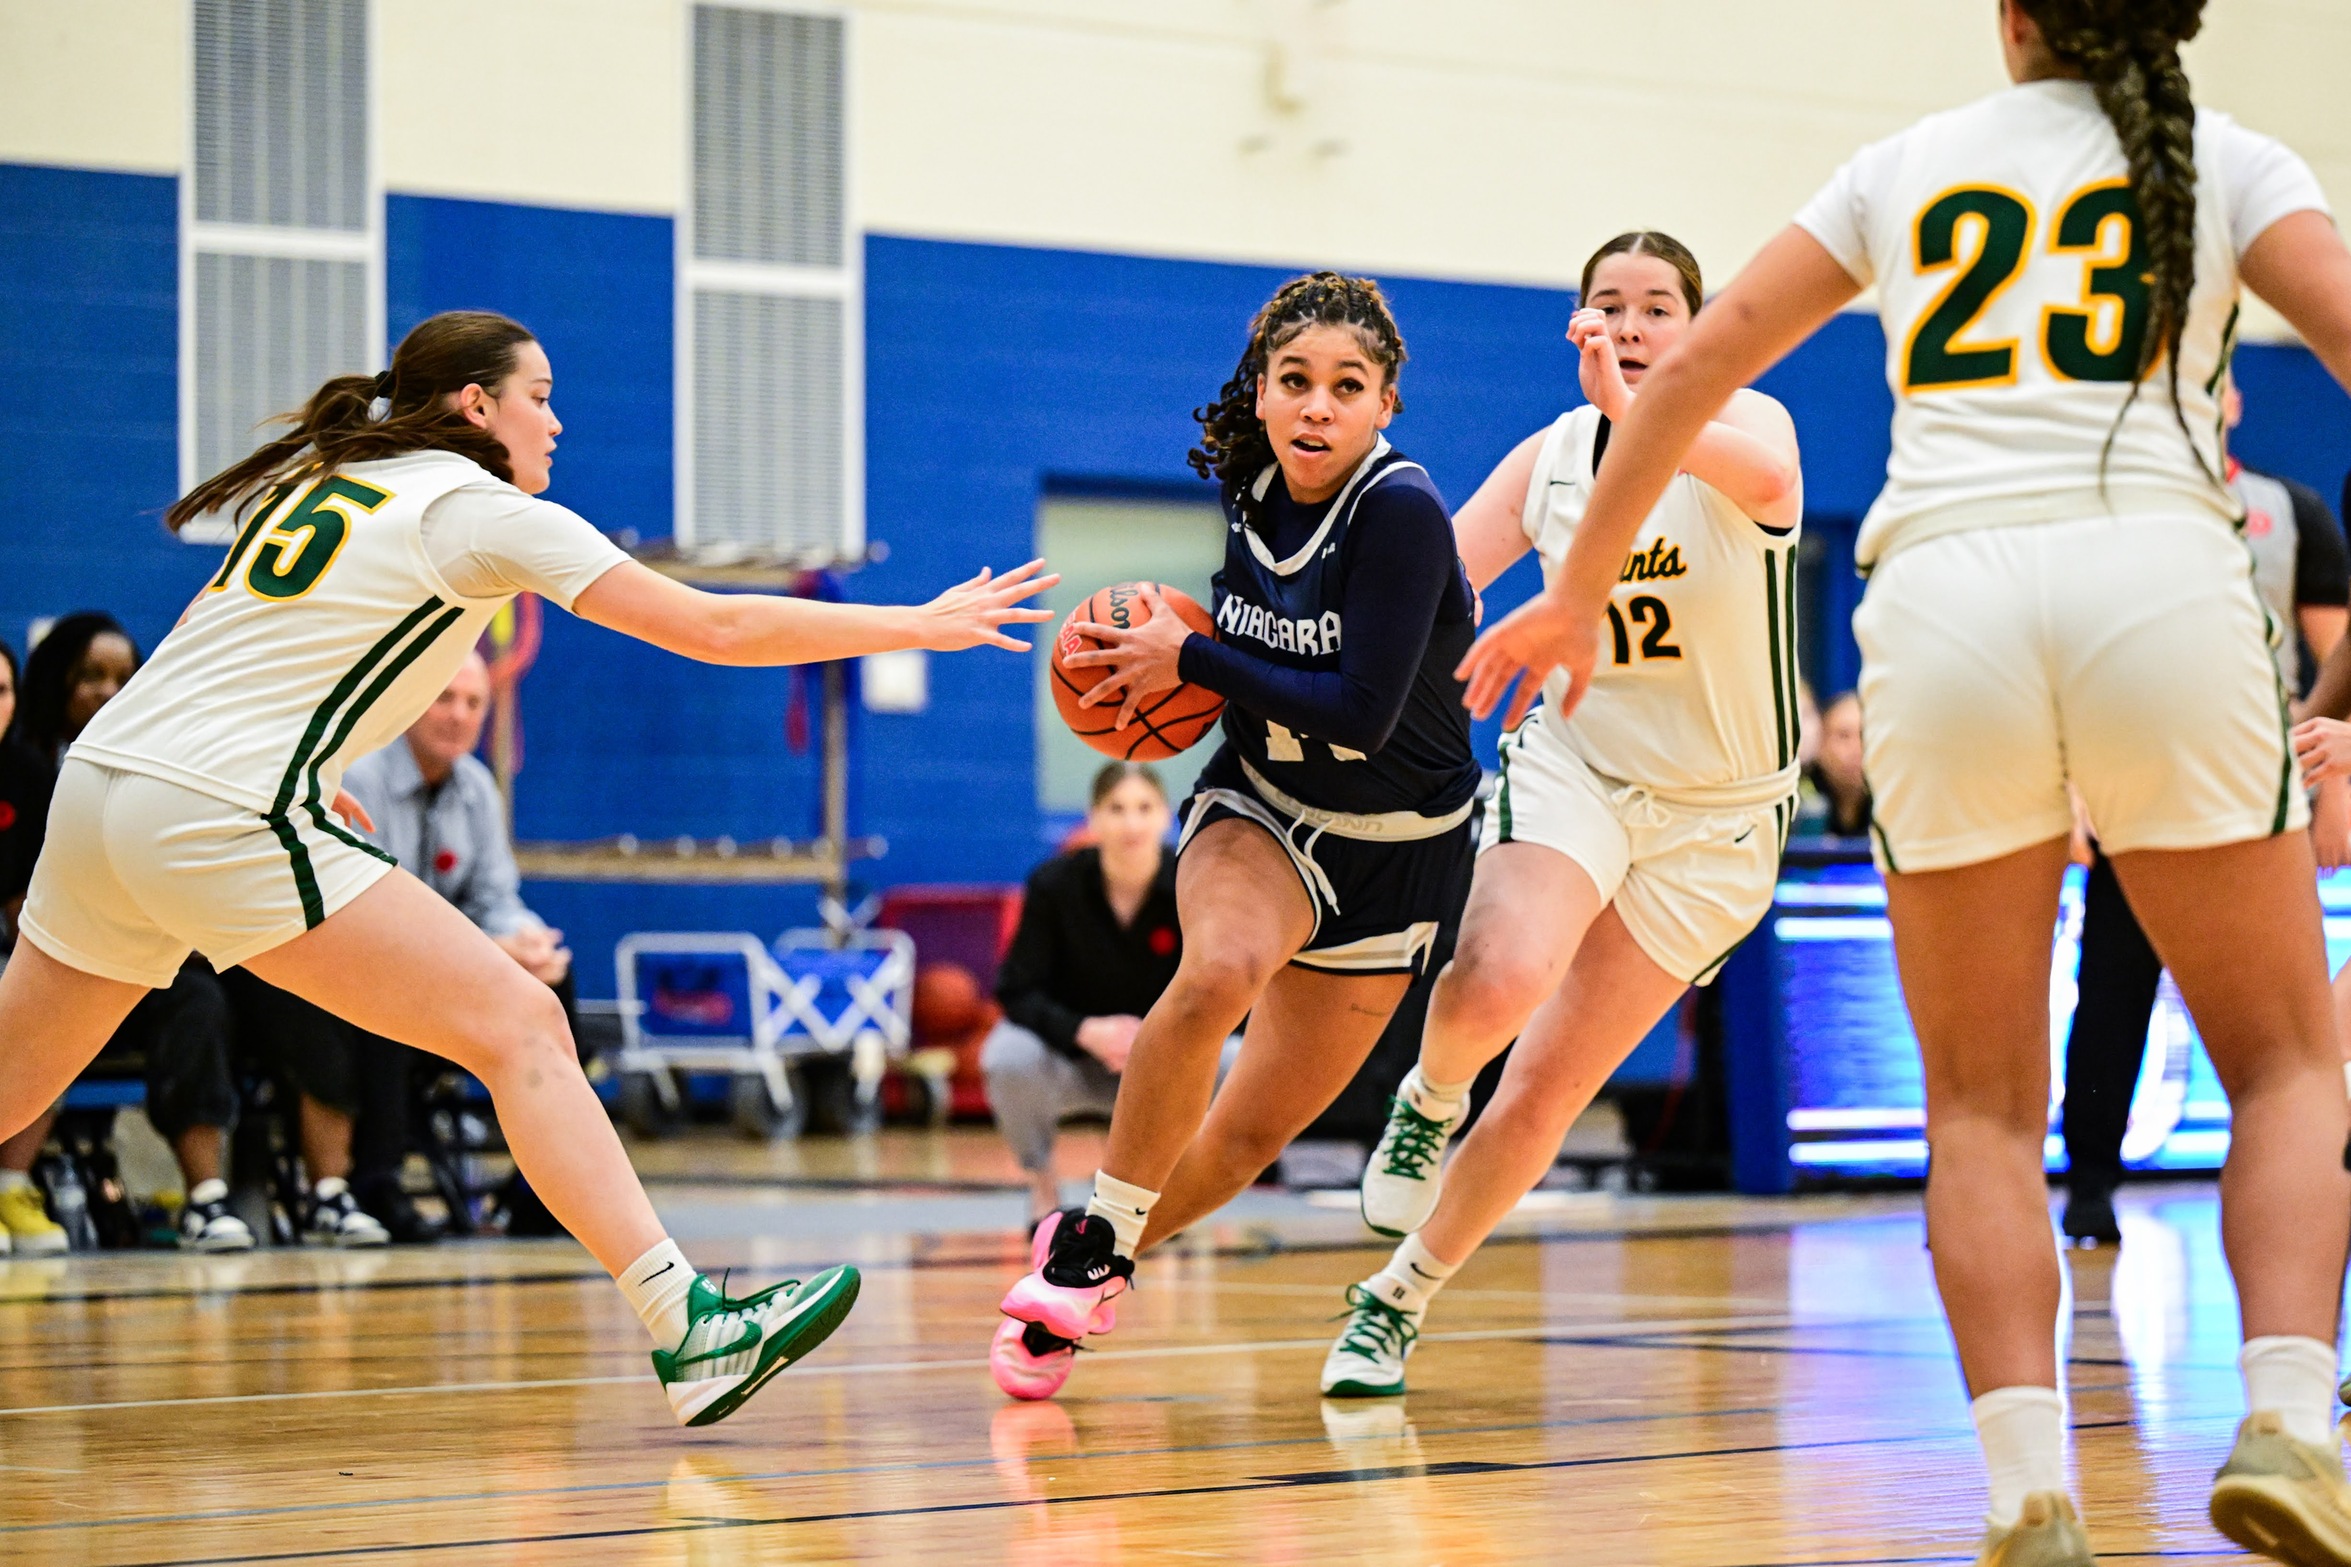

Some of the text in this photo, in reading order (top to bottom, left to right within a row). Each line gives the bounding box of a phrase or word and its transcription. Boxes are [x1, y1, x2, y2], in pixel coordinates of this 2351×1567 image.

[1900, 177, 2168, 396] 23
[209, 461, 398, 603] 15
[1216, 593, 1342, 657] NIAGARA
[1602, 594, 1683, 666] 12
